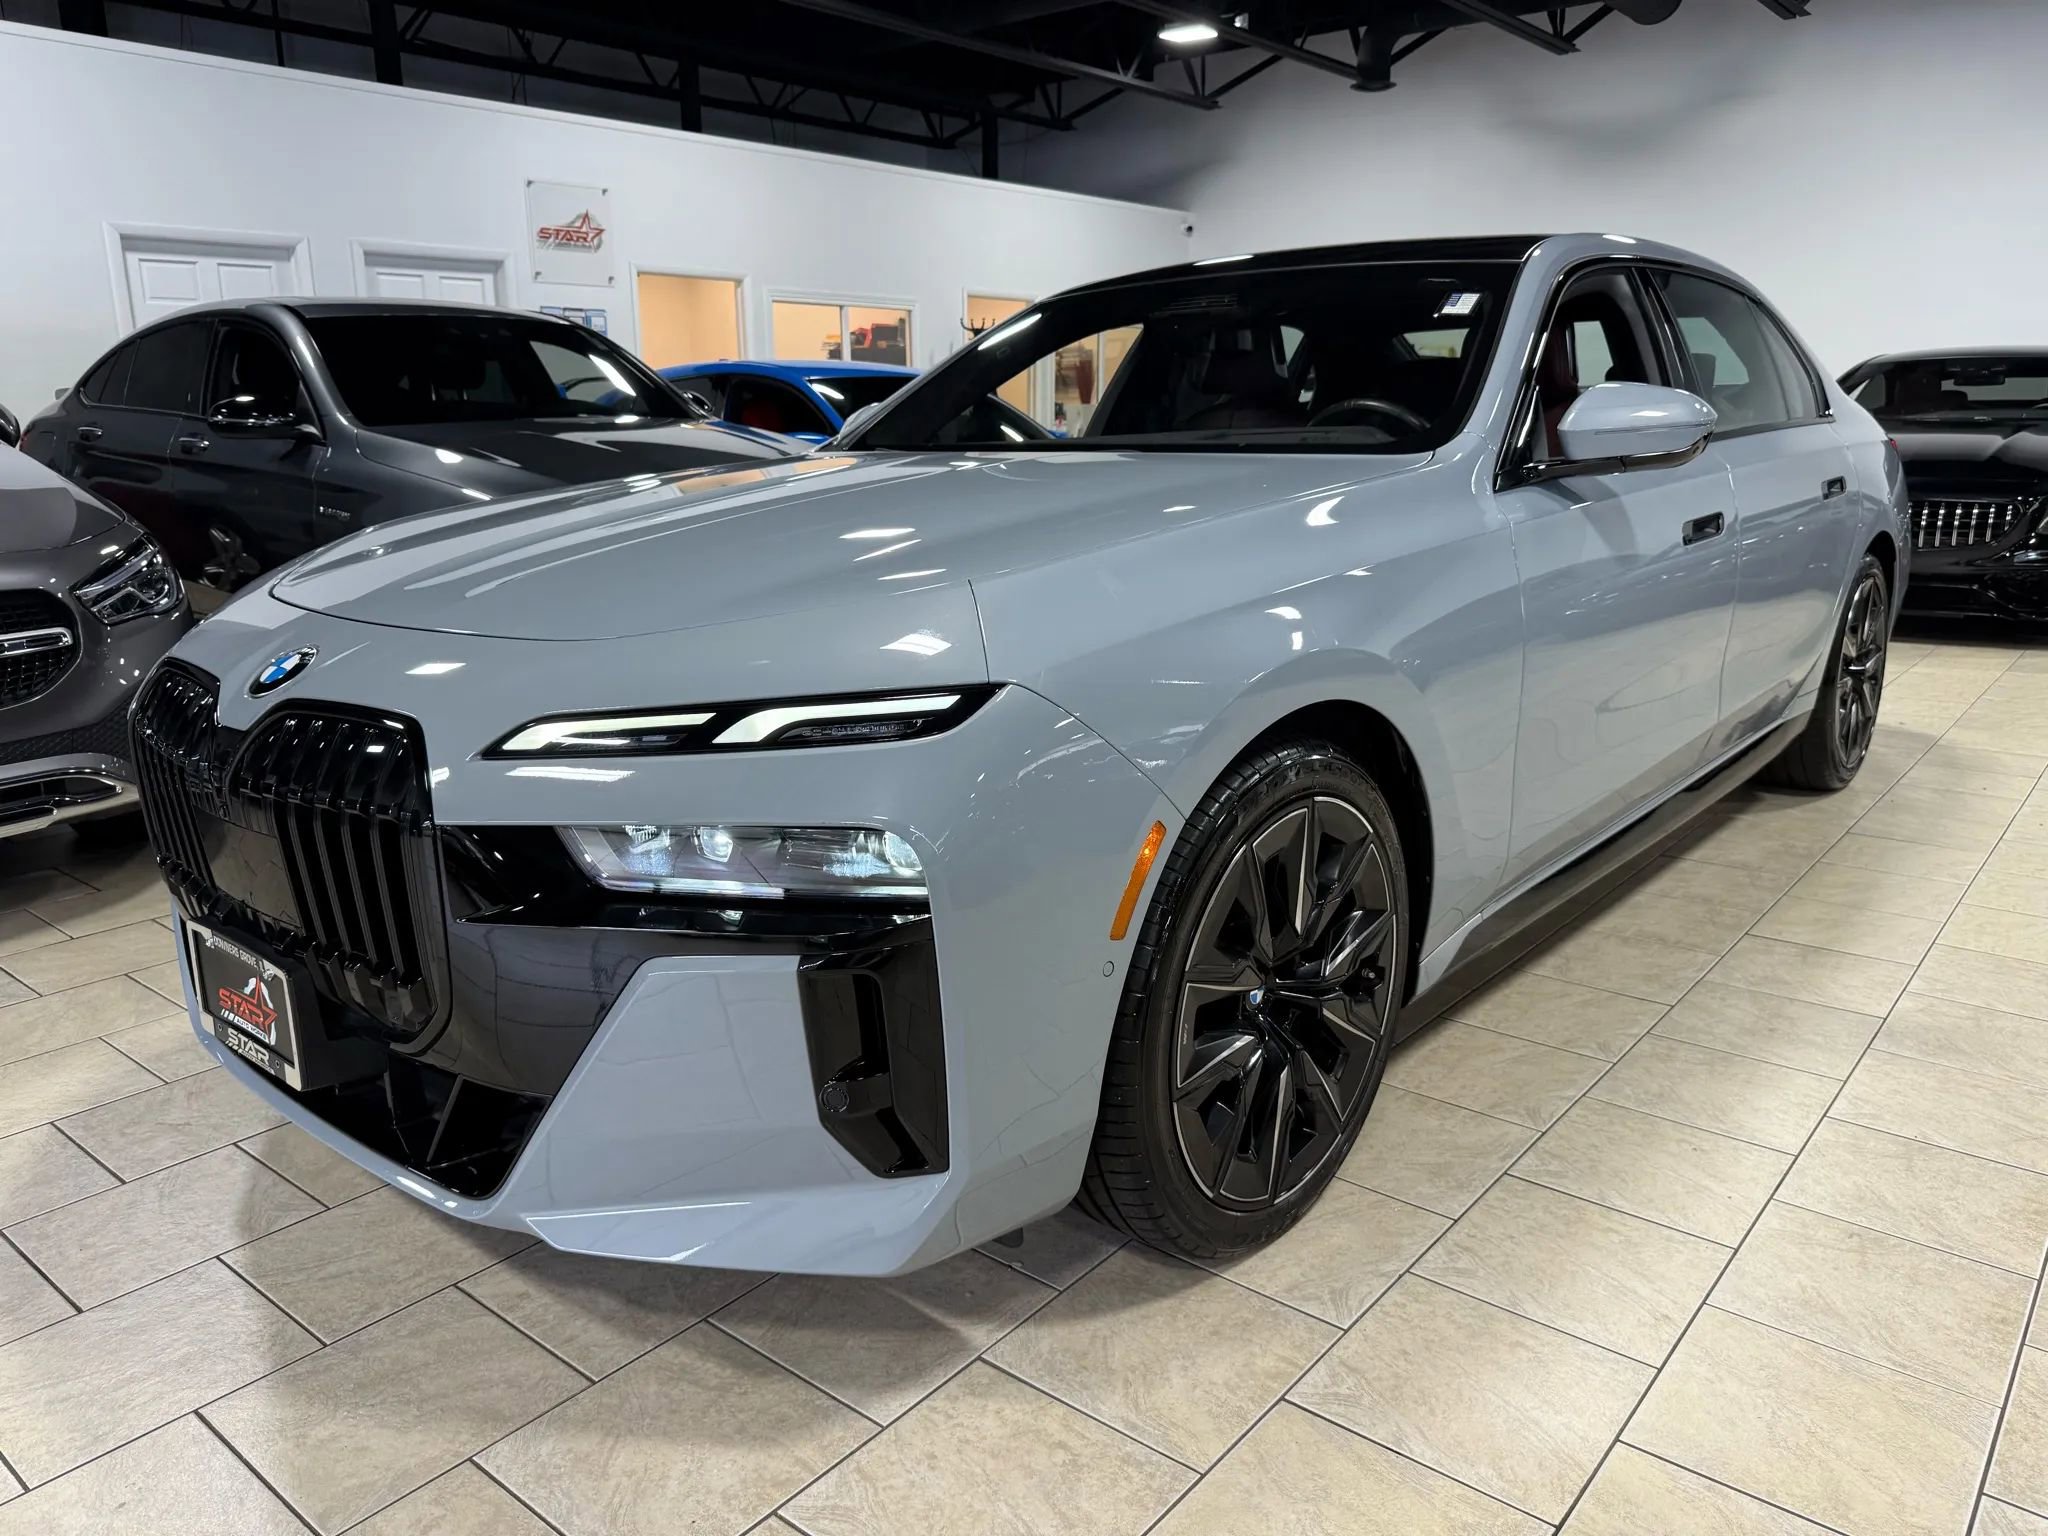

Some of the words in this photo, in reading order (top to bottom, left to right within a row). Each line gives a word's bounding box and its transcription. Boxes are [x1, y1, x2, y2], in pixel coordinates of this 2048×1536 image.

[537, 227, 590, 243] STAR
[213, 935, 239, 958] DOWNERS
[219, 988, 264, 1030] STAR
[236, 1017, 250, 1029] AUTO
[227, 1027, 270, 1067] STAR
